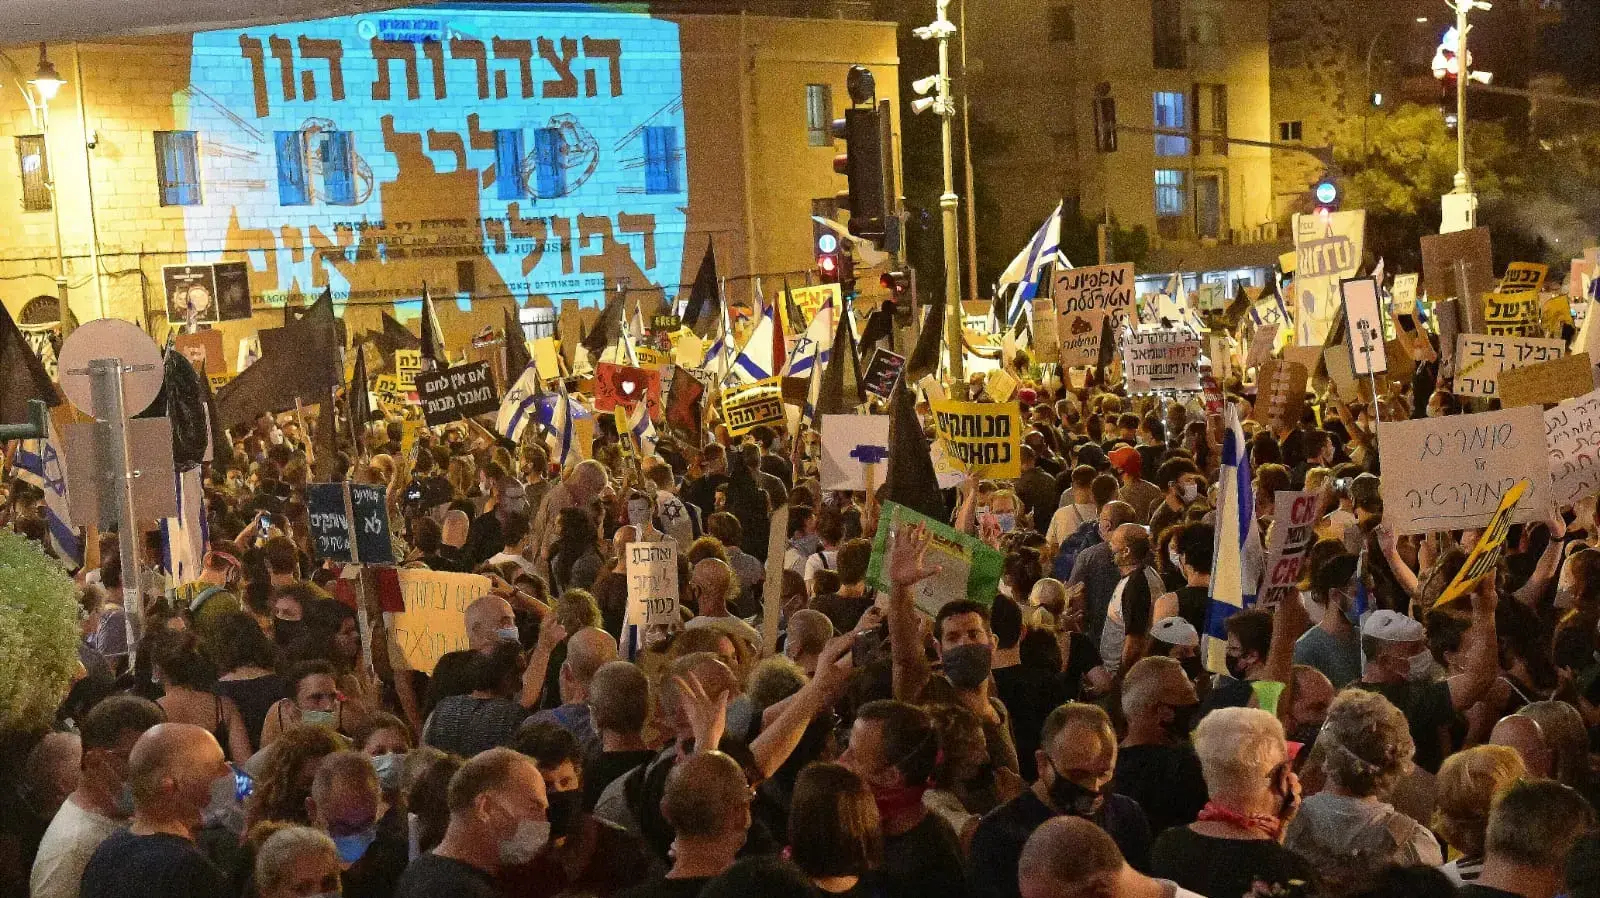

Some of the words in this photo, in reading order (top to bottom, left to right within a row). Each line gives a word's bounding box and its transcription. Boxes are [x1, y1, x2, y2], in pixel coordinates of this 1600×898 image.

[239, 34, 345, 118] הון
[370, 35, 622, 100] הצהרות
[226, 202, 656, 290] הפוליאים
[1464, 341, 1505, 358] ביבי
[425, 376, 449, 393] לחם
[947, 440, 1011, 465] נמאס
[1420, 423, 1520, 461] שומרים
[632, 546, 672, 564] ואהבת
[640, 597, 675, 623] כמוך
